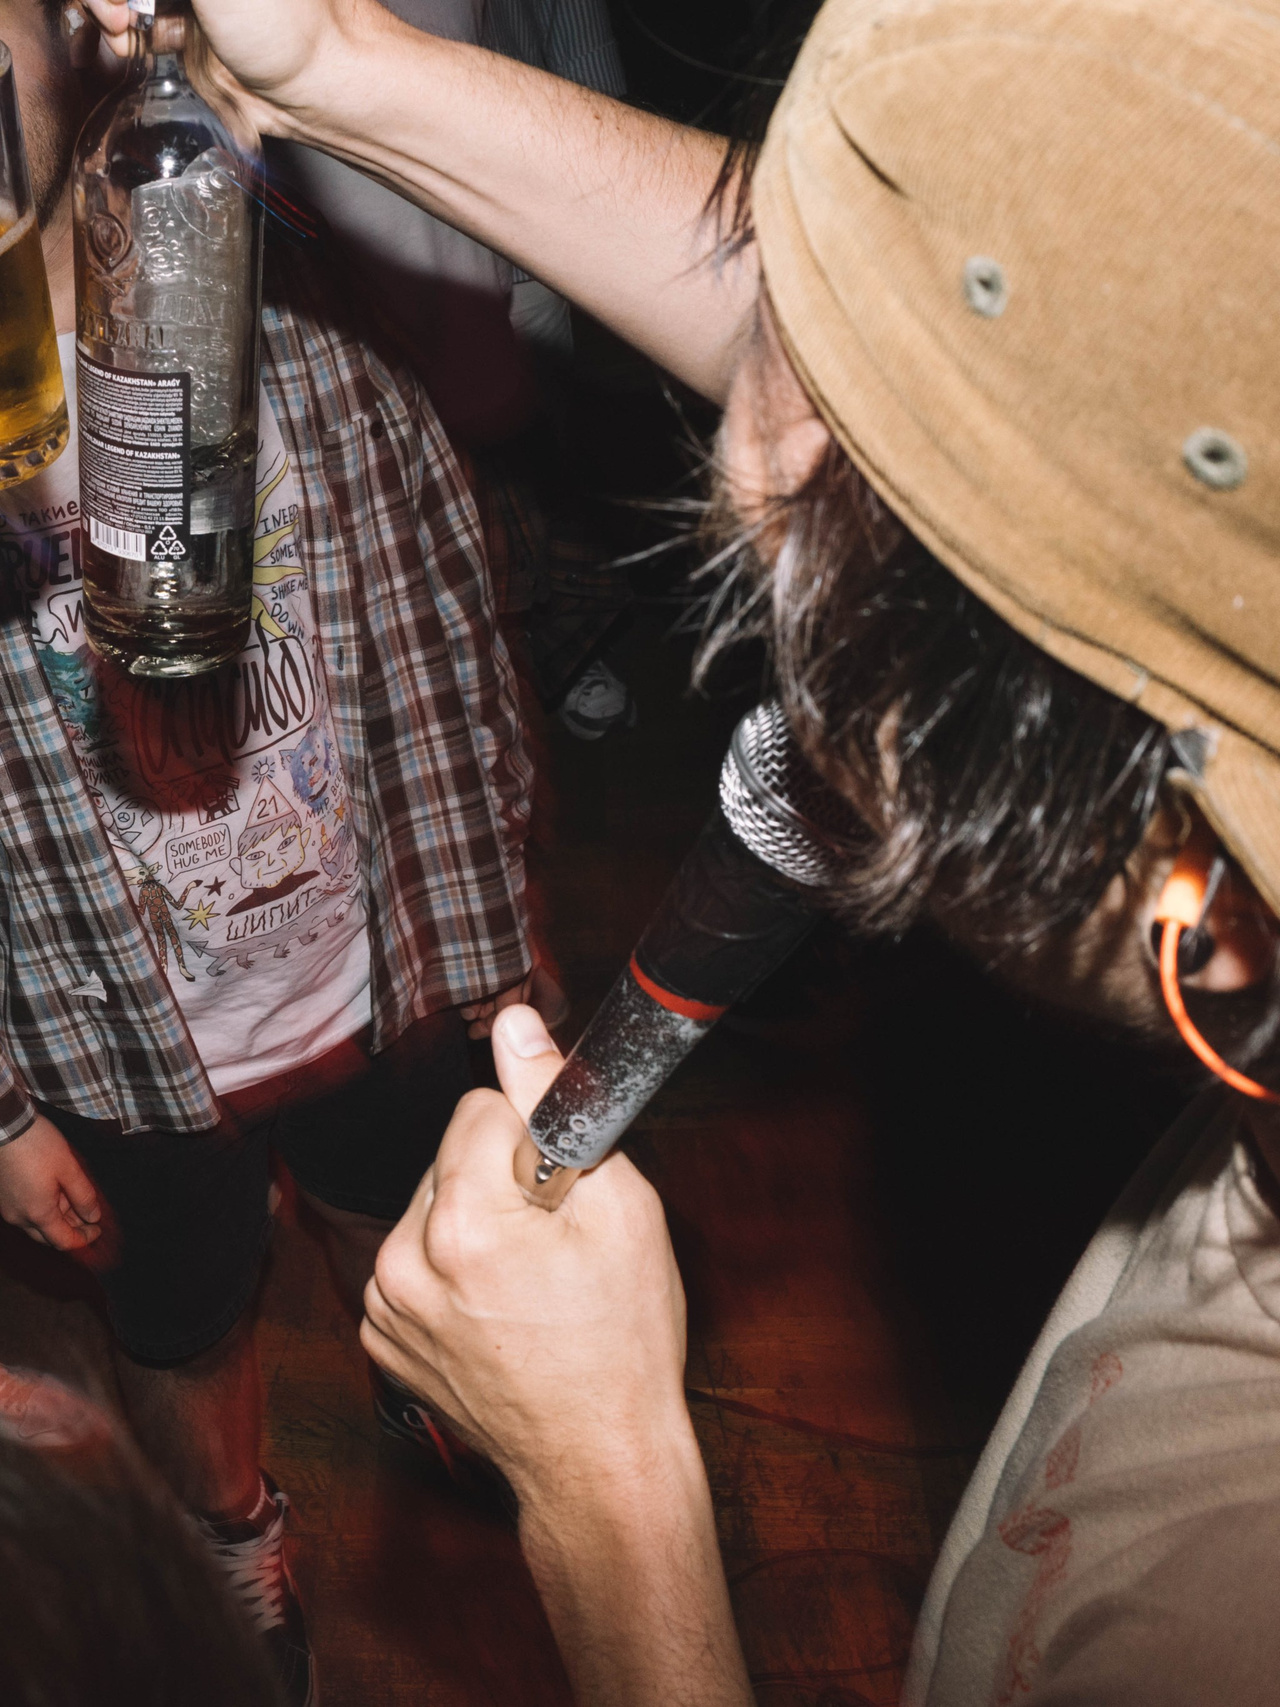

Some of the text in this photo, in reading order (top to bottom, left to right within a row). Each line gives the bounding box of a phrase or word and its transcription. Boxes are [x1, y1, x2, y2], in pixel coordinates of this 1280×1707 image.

[126, 449, 134, 457] OF
[271, 504, 299, 527] NEED
[83, 767, 130, 787] ОГУЛЯТЬ
[256, 795, 279, 820] 21
[170, 828, 227, 858] SOMEBODY
[173, 846, 227, 871] HUG ME
[226, 885, 318, 941] ШИПИТ
